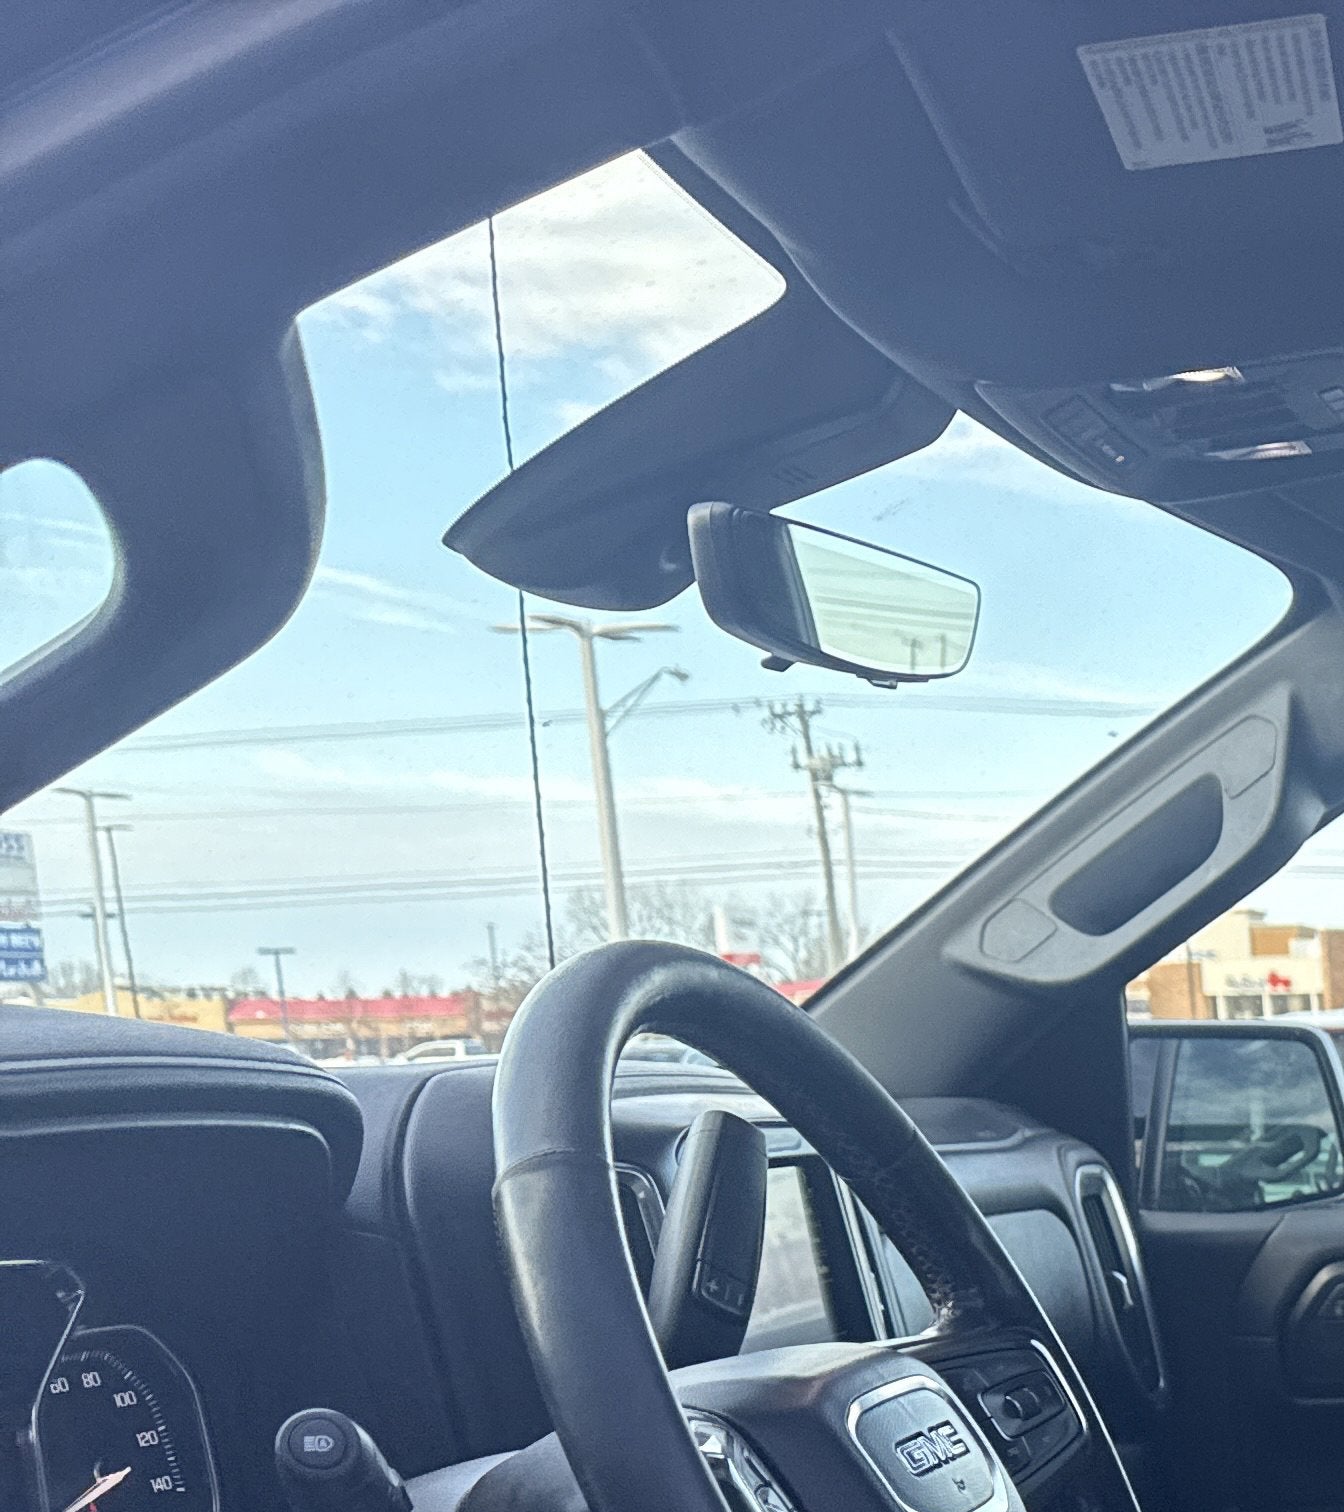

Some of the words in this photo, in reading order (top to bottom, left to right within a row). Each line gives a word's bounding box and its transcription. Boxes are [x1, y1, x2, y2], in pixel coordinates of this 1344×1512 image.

[81, 1371, 101, 1388] 80
[113, 1390, 137, 1408] 100
[136, 1430, 159, 1447] 120
[894, 1420, 970, 1476] GMC
[150, 1475, 173, 1493] 140
